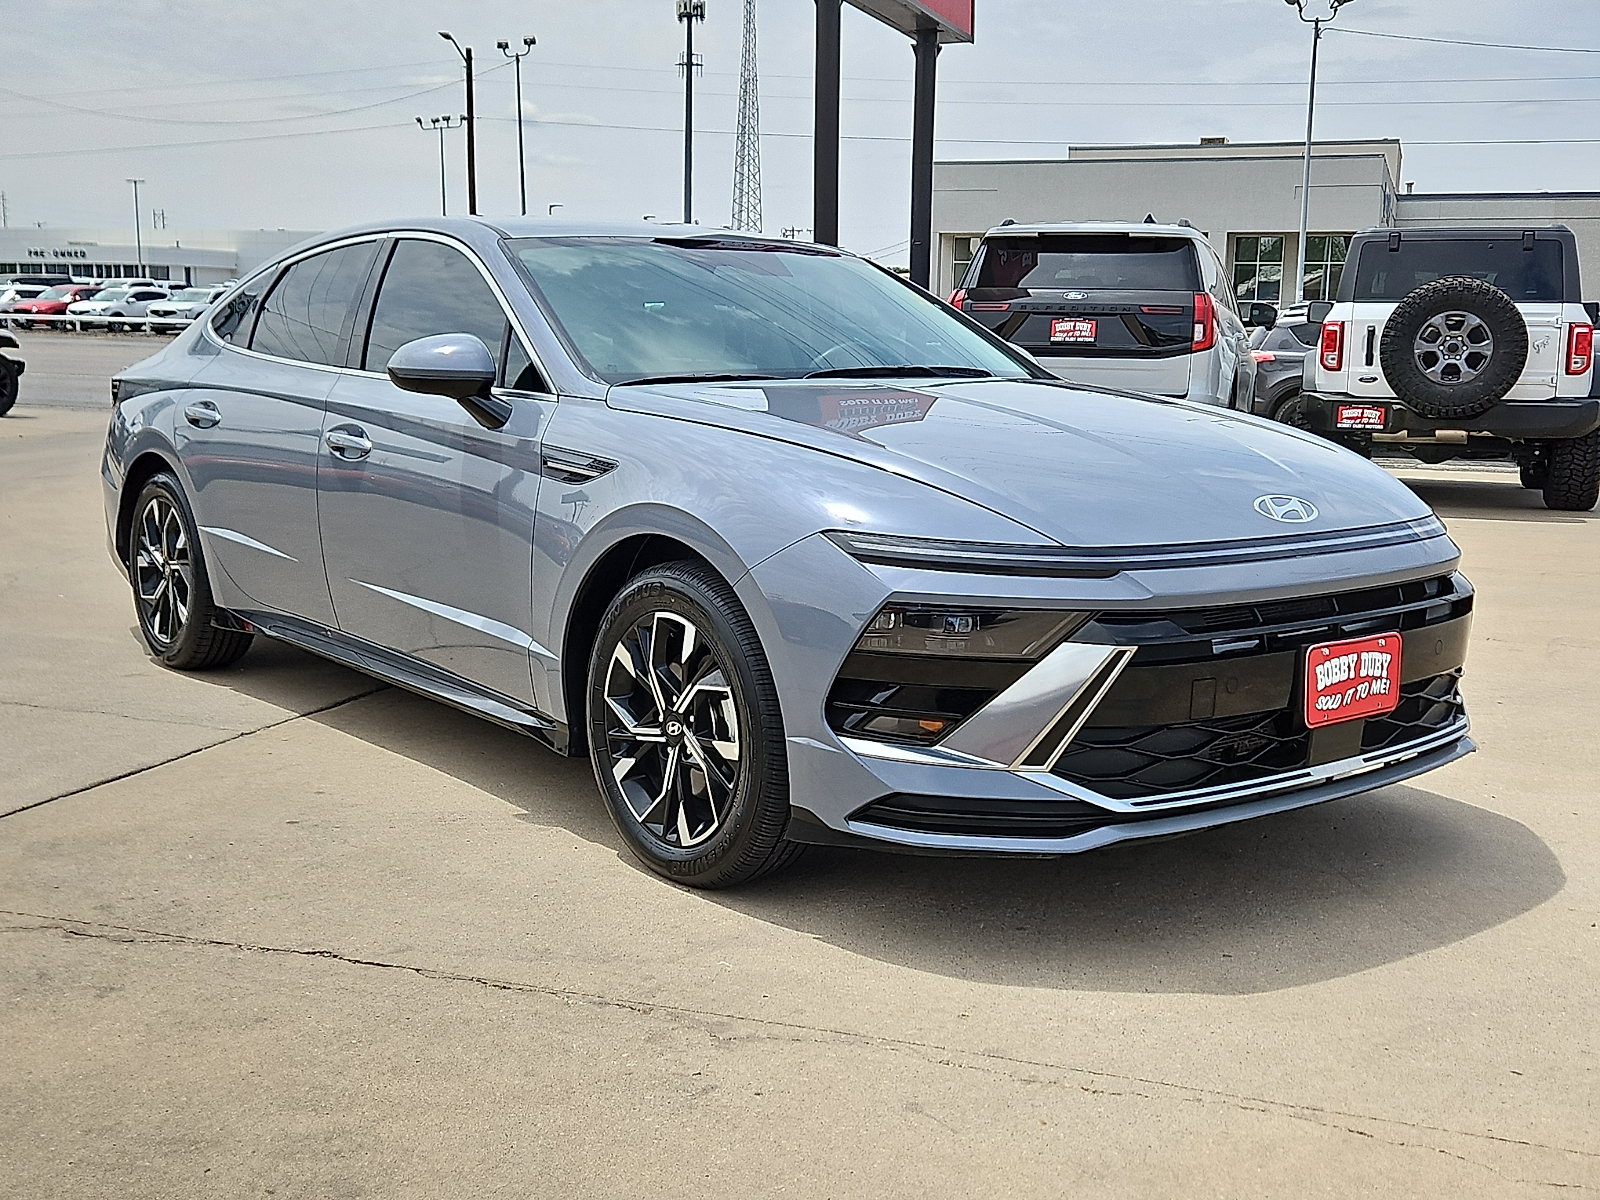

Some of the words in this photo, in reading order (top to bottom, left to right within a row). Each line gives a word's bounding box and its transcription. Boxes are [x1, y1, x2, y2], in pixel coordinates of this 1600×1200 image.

[1019, 304, 1131, 312] EXPEDITION
[1315, 653, 1358, 691] BOBBY
[1360, 652, 1391, 678] DUBY
[1315, 693, 1342, 710] SOLD
[1343, 688, 1356, 706] IT
[1356, 681, 1370, 701] TO
[1370, 678, 1390, 695] ME!
